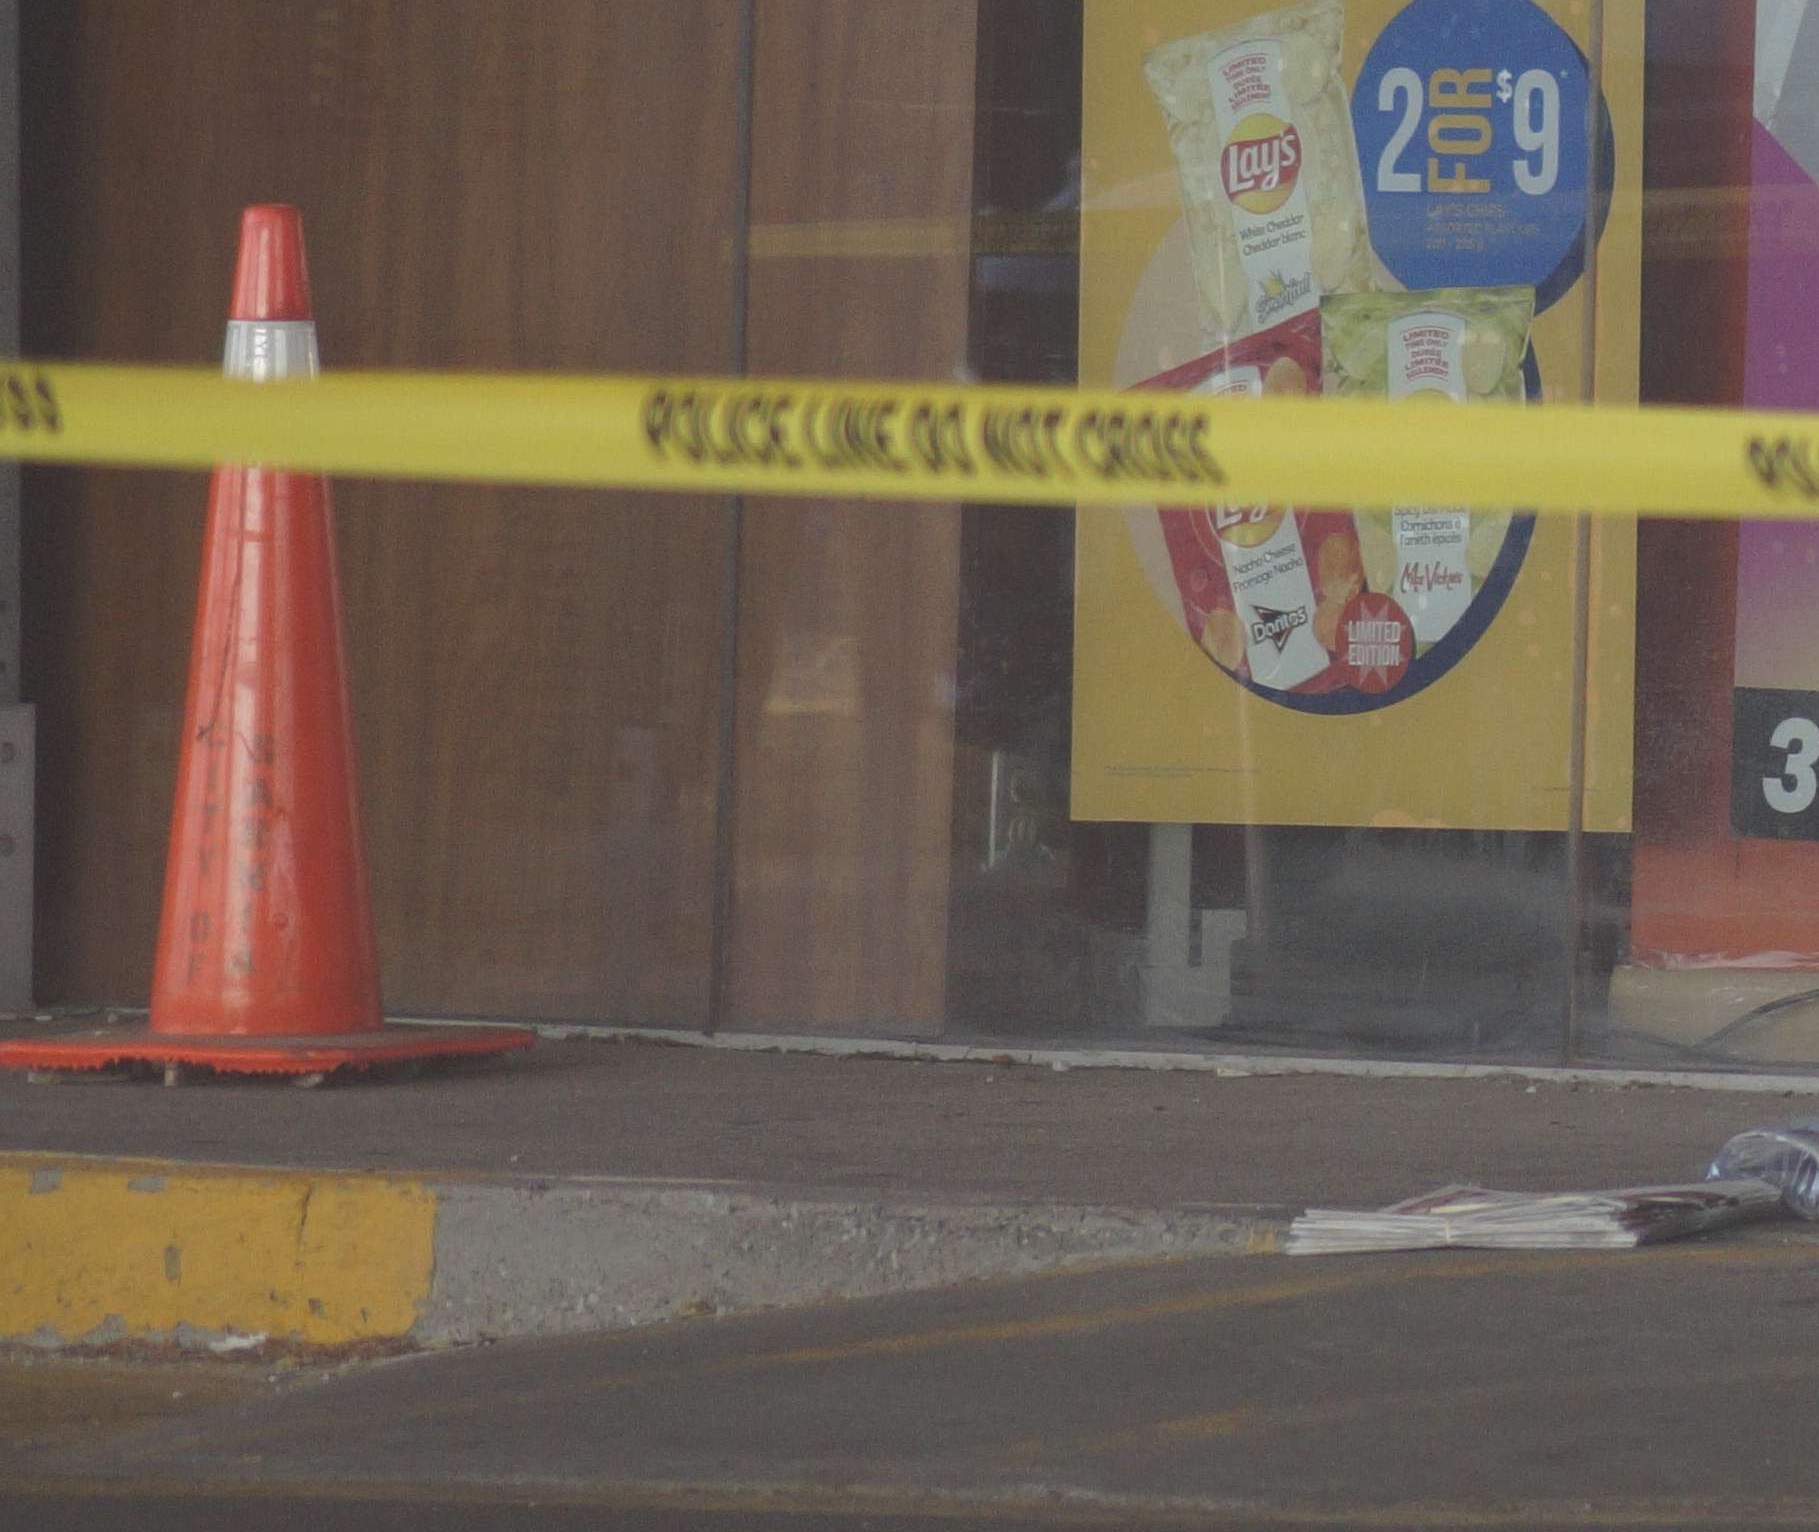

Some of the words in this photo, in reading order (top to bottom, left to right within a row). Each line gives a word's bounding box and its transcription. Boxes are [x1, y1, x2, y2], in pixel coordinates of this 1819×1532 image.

[1377, 66, 1424, 193] 2
[1427, 68, 1493, 194] FOR
[1228, 132, 1297, 194] Lay's
[1243, 237, 1281, 257] Cheddar
[645, 389, 800, 469] POLICE
[1252, 604, 1308, 645] Doritos
[1349, 621, 1401, 643] LIMITED
[1349, 643, 1401, 666] EDITION
